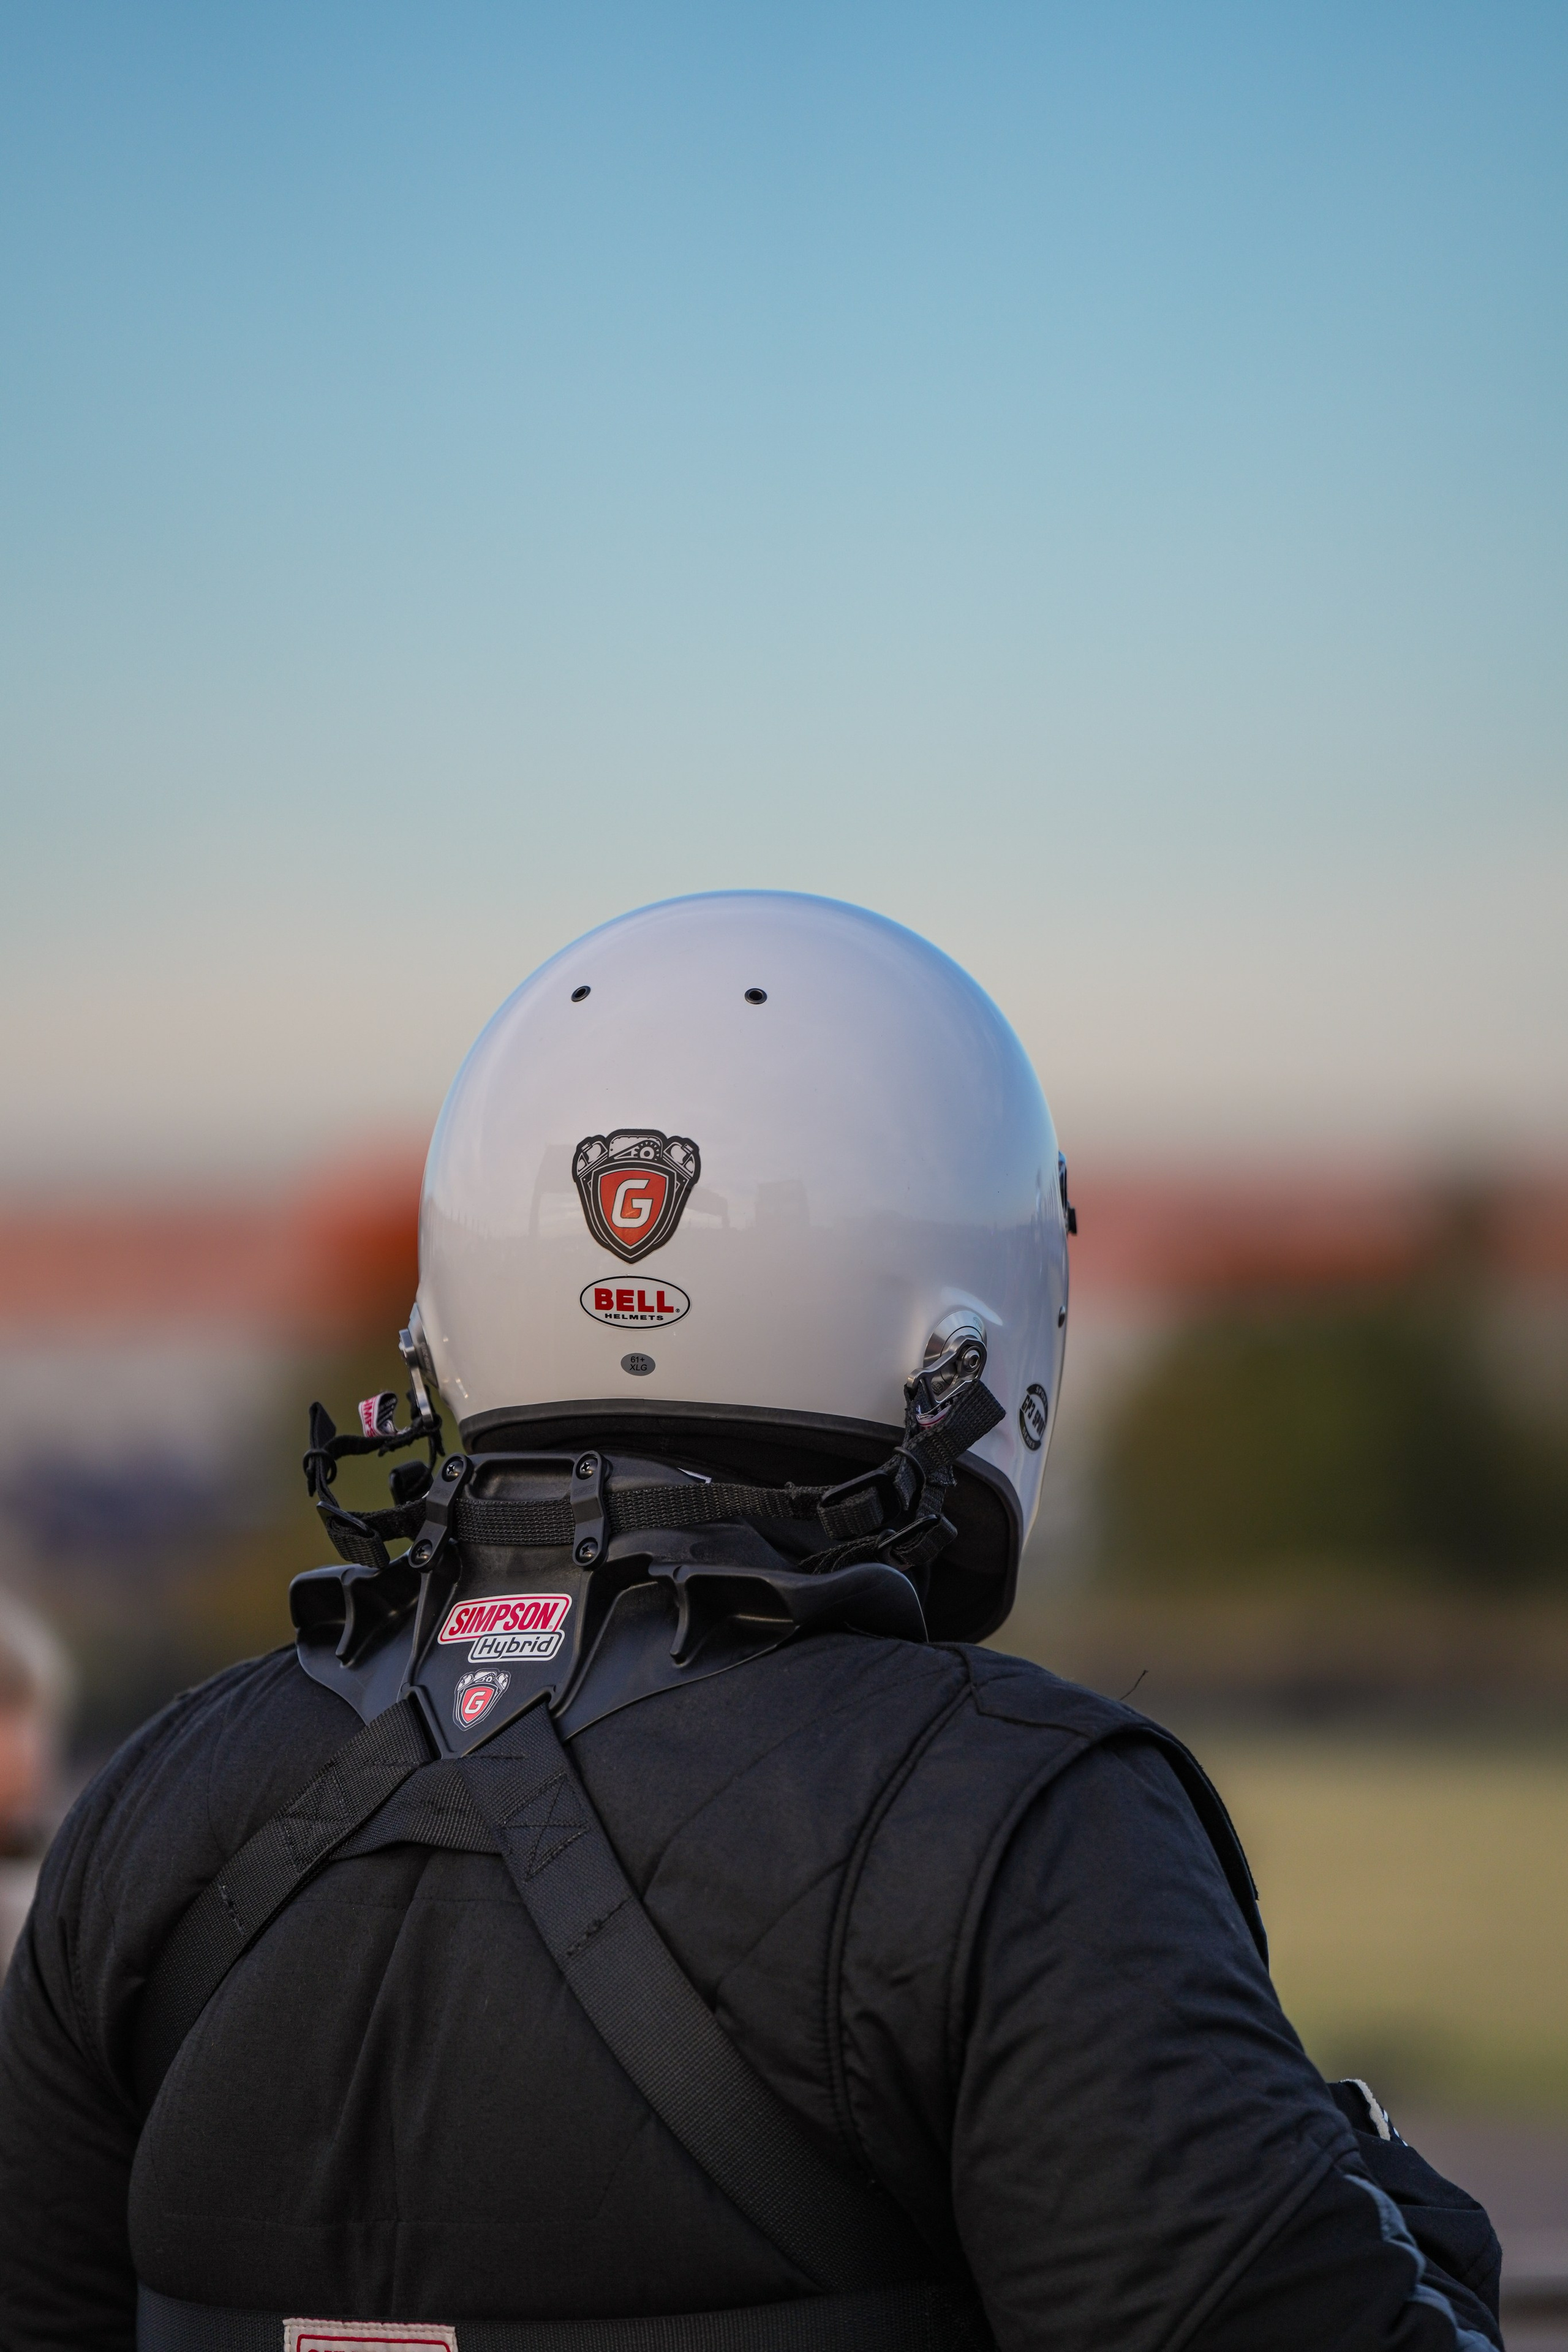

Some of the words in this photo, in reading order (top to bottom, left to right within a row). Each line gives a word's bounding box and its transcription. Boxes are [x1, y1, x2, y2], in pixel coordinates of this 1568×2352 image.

[611, 1178, 654, 1229] G
[594, 1288, 674, 1313] BELL
[1022, 1394, 1036, 1420] GP3
[1022, 1427, 1036, 1449] SERIES
[448, 1602, 560, 1636] SIMPSON
[478, 1636, 554, 1658] Hybrid
[464, 1691, 487, 1714] G
